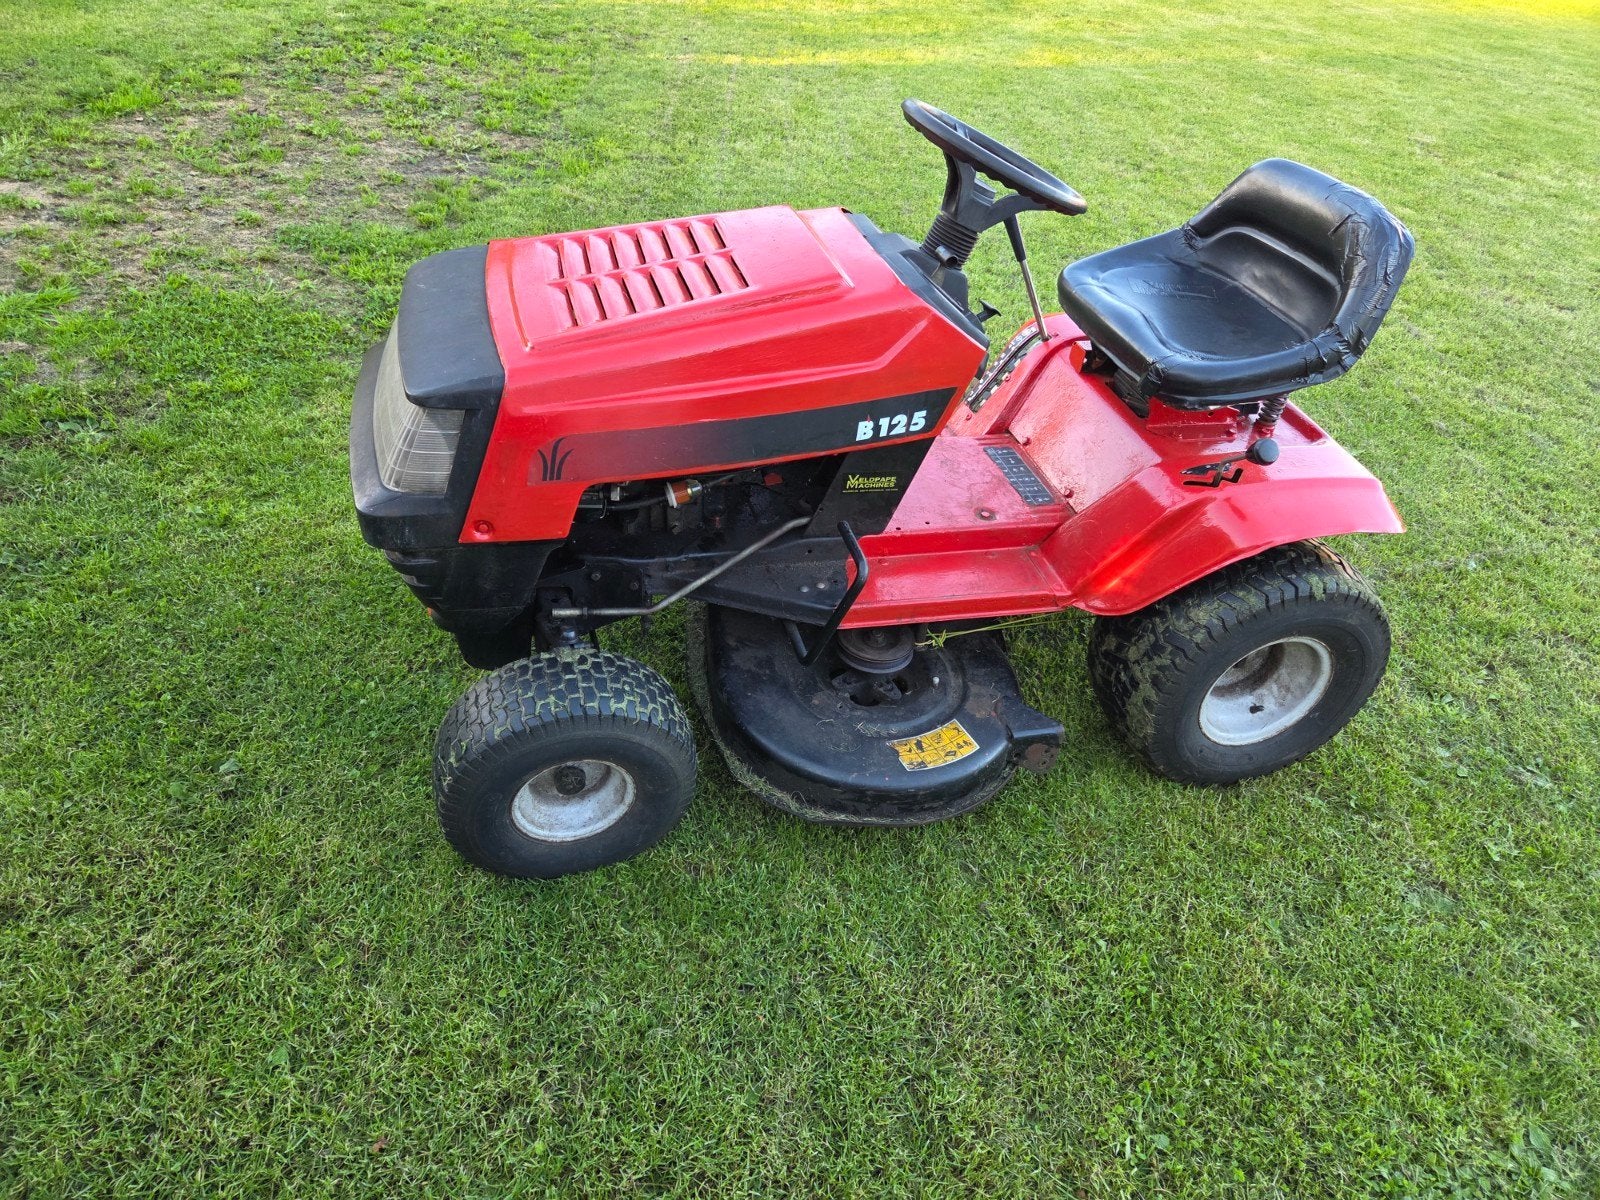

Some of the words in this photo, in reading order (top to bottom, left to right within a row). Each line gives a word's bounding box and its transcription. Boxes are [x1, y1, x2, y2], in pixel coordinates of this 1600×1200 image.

[855, 420, 874, 442] B
[878, 410, 927, 438] 125
[848, 474, 897, 483] VELOPAPE
[846, 480, 896, 489] MACHINES
